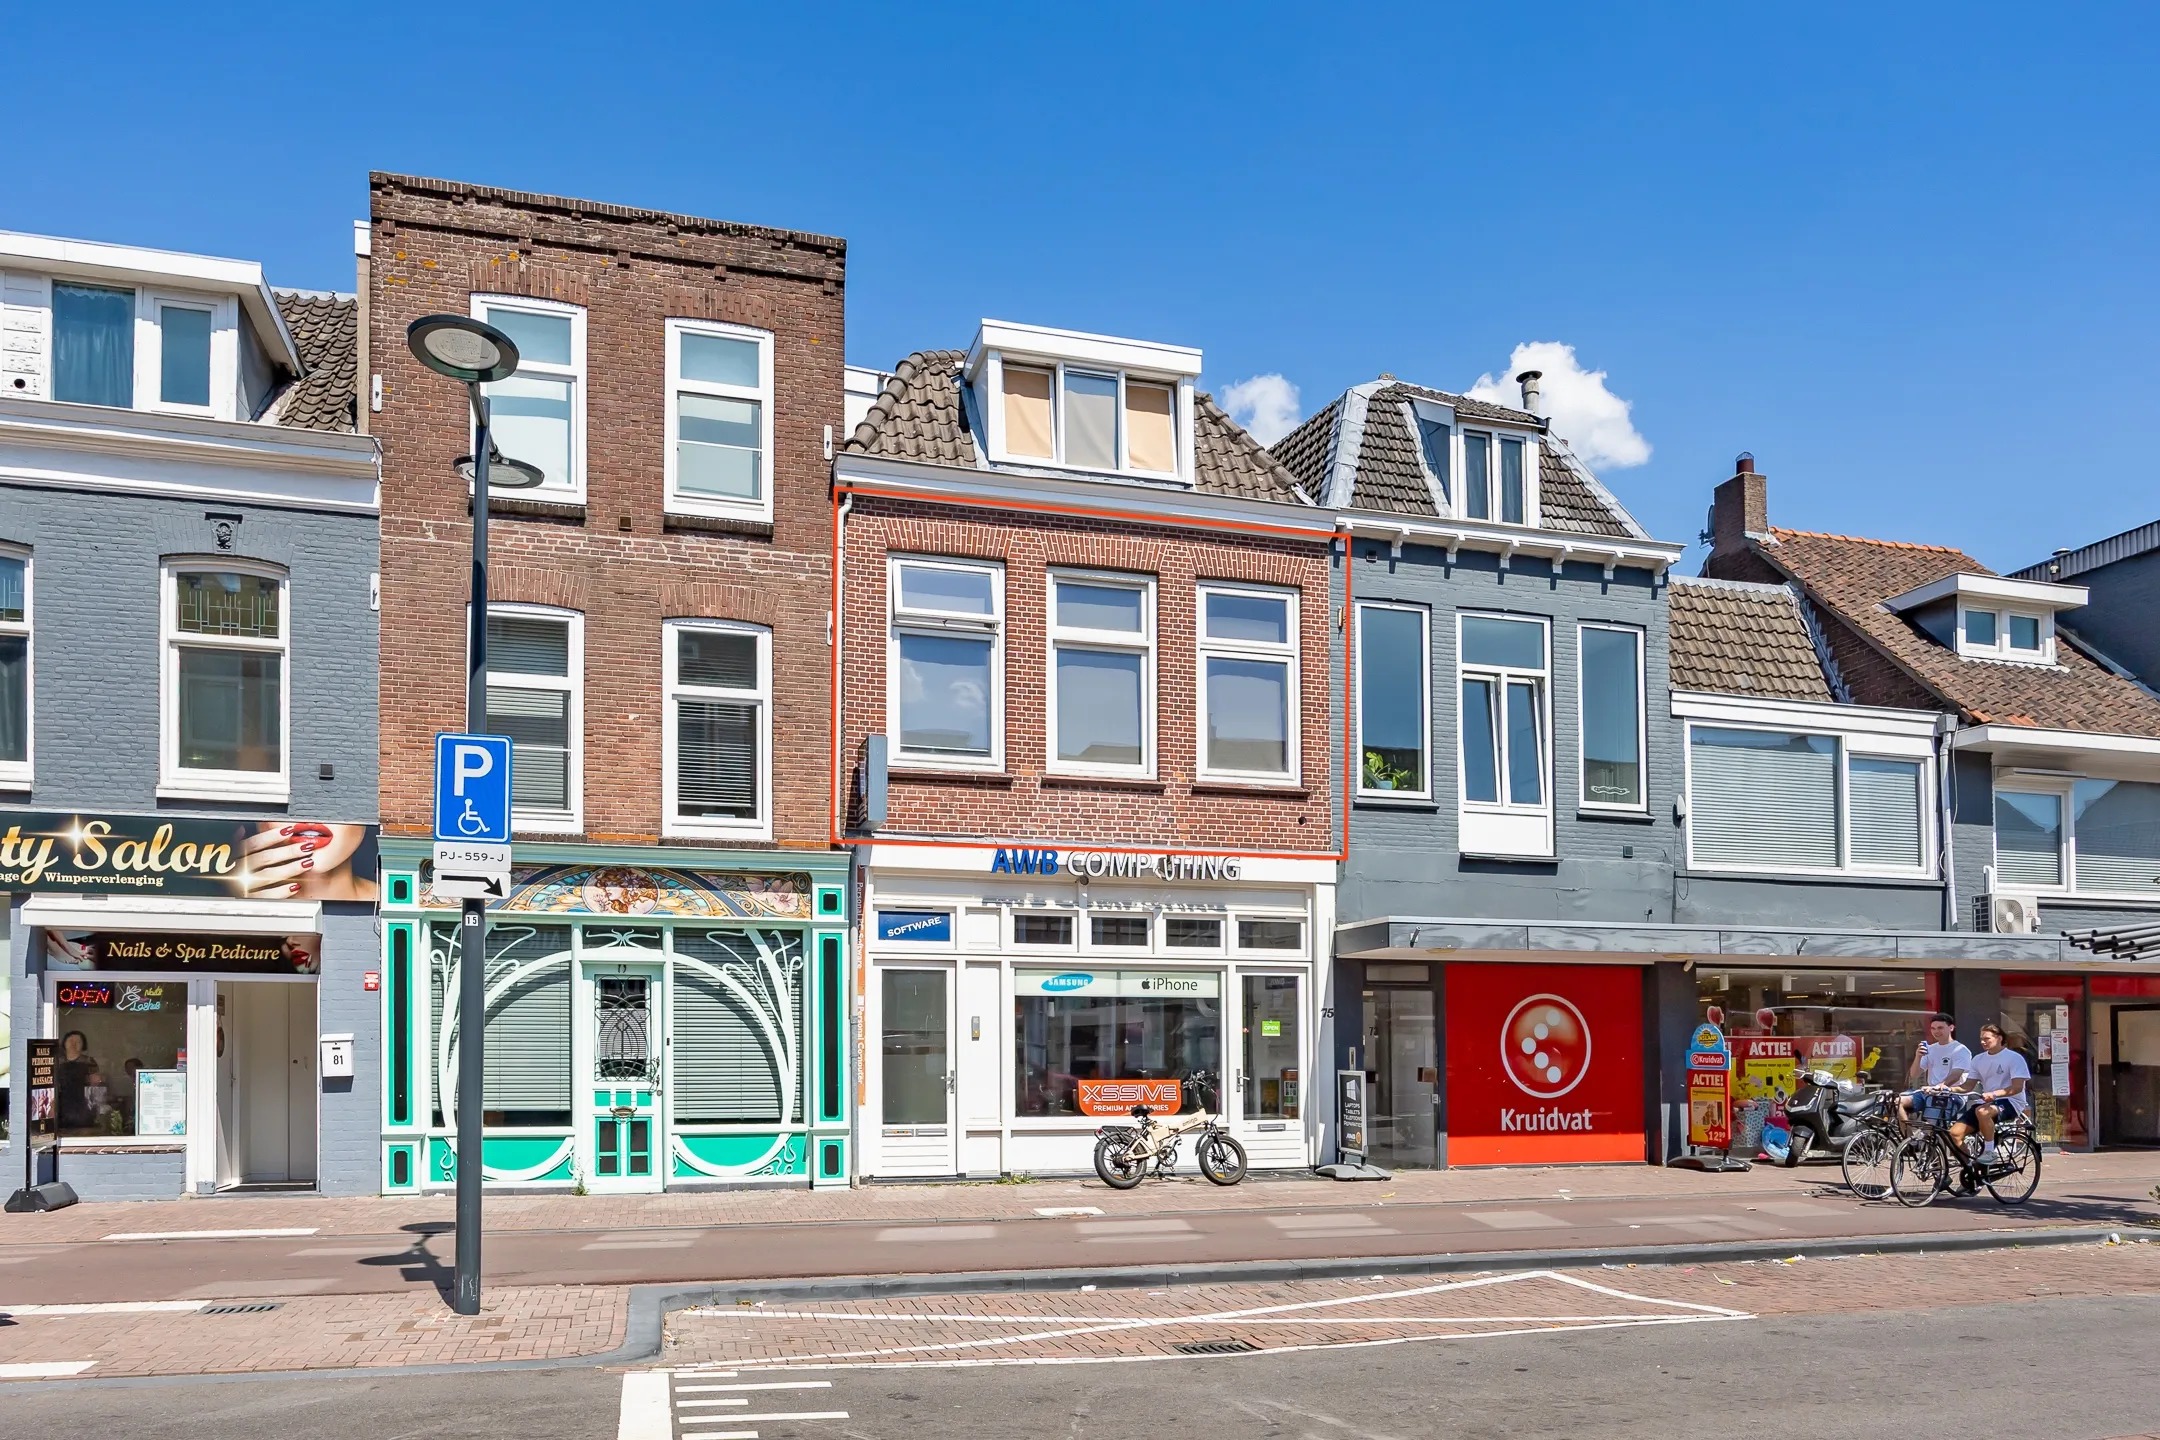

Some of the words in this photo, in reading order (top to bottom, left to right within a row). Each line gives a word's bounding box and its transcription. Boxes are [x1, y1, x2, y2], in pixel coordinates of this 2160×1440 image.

[453, 744, 494, 797] P
[72, 820, 236, 874] Salon
[440, 851, 504, 863] PJ-559-J
[990, 847, 1060, 876] AWB
[1066, 850, 1242, 882] COMPUTING
[44, 871, 164, 888] Wimperverlenging
[466, 916, 478, 925] 15
[887, 915, 943, 938] SOFTWARE
[107, 941, 152, 958] Nails
[155, 942, 172, 958] &
[175, 943, 206, 963] Spa
[209, 943, 280, 961] Pedicure
[1048, 977, 1089, 987] SAMSUNG
[1152, 977, 1199, 991] iPhone
[59, 987, 111, 1004] OPEN
[1320, 1007, 1335, 1019] 75
[1263, 1024, 1280, 1032] OPEN
[1749, 1041, 1792, 1056] ACTIE!
[1812, 1041, 1854, 1056] ACTIE!
[333, 1054, 344, 1065] 81
[1699, 1054, 1723, 1065] Kruidvat
[1692, 1073, 1724, 1087] ACTIE!
[1081, 1084, 1178, 1102] XSSIVE
[1093, 1104, 1124, 1112] PREMIUM
[1501, 1106, 1593, 1132] Kruidvat
